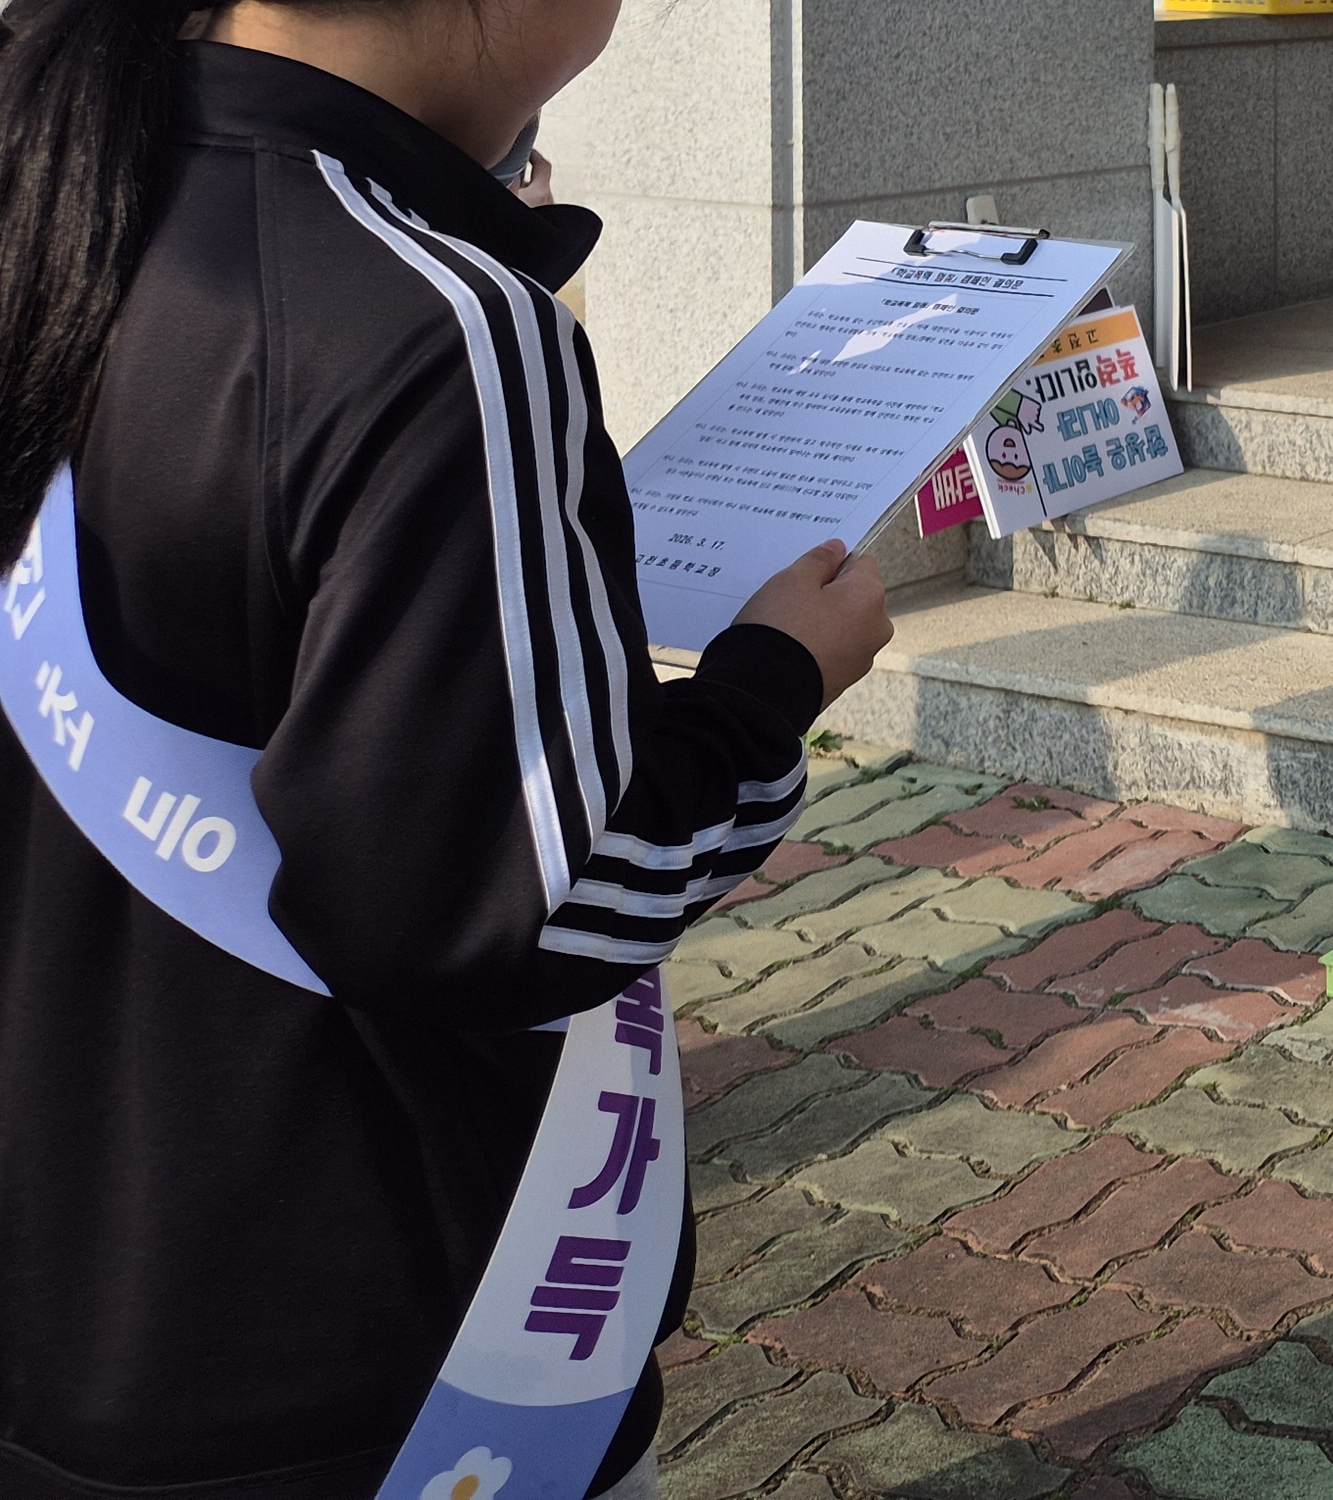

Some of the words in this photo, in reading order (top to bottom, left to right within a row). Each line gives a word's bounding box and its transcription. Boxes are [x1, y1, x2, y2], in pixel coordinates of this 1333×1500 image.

[1056, 397, 1121, 443] 아니라
[1042, 443, 1105, 495] 놀이가
[1105, 424, 1168, 472] 합성은
